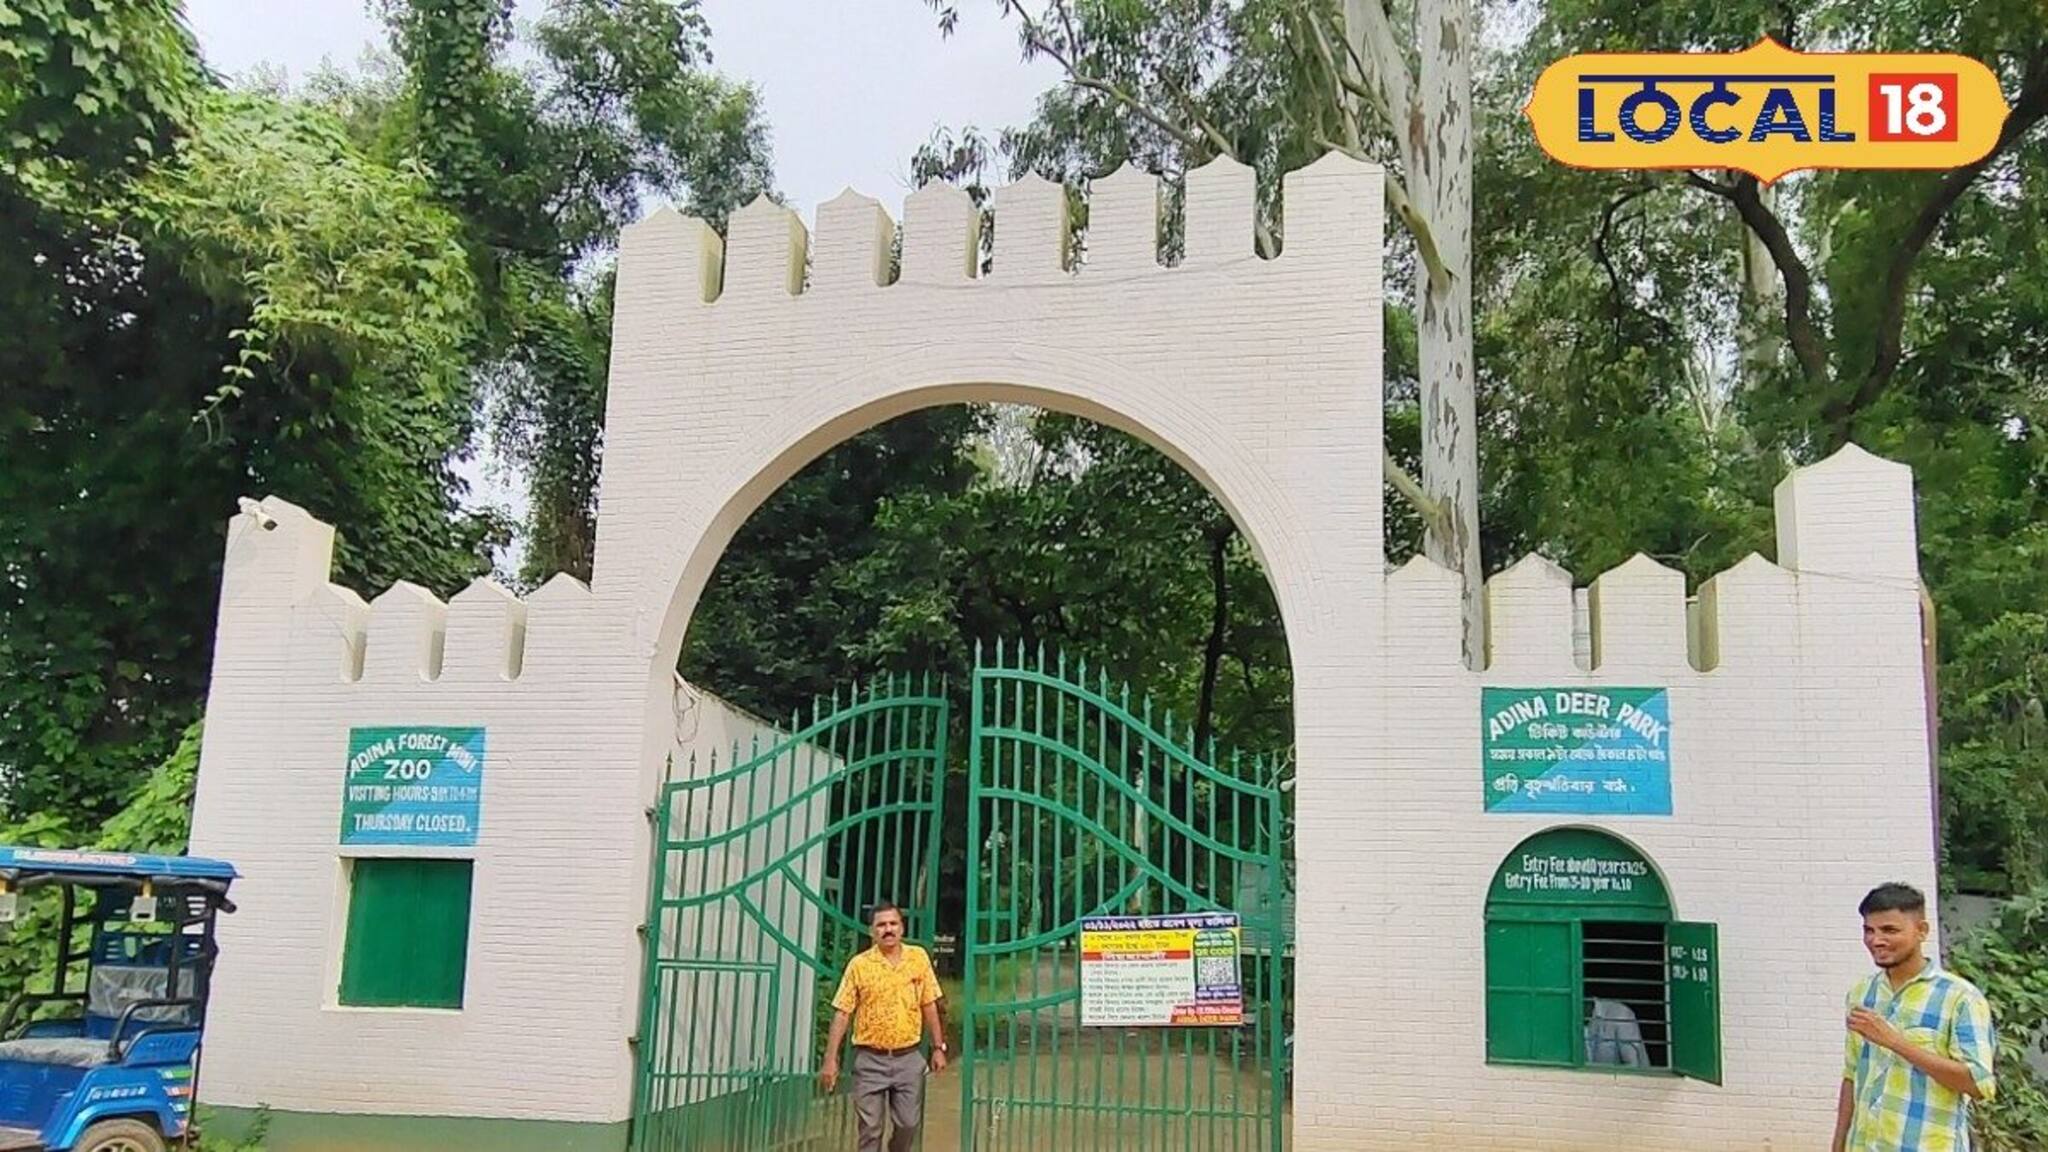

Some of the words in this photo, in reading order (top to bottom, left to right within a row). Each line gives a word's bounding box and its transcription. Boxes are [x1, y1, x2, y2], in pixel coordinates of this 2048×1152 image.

[1489, 696, 1548, 741] ADINA
[1556, 692, 1610, 718] DEER
[1615, 703, 1669, 746] PARK
[350, 738, 396, 779] ADINA
[398, 733, 449, 753] FOREST
[383, 758, 432, 780] ZOO
[349, 785, 391, 801] VISITING
[354, 814, 415, 832] THURSDAY
[1523, 854, 1549, 876] Entry
[1505, 872, 1532, 893] Entry
